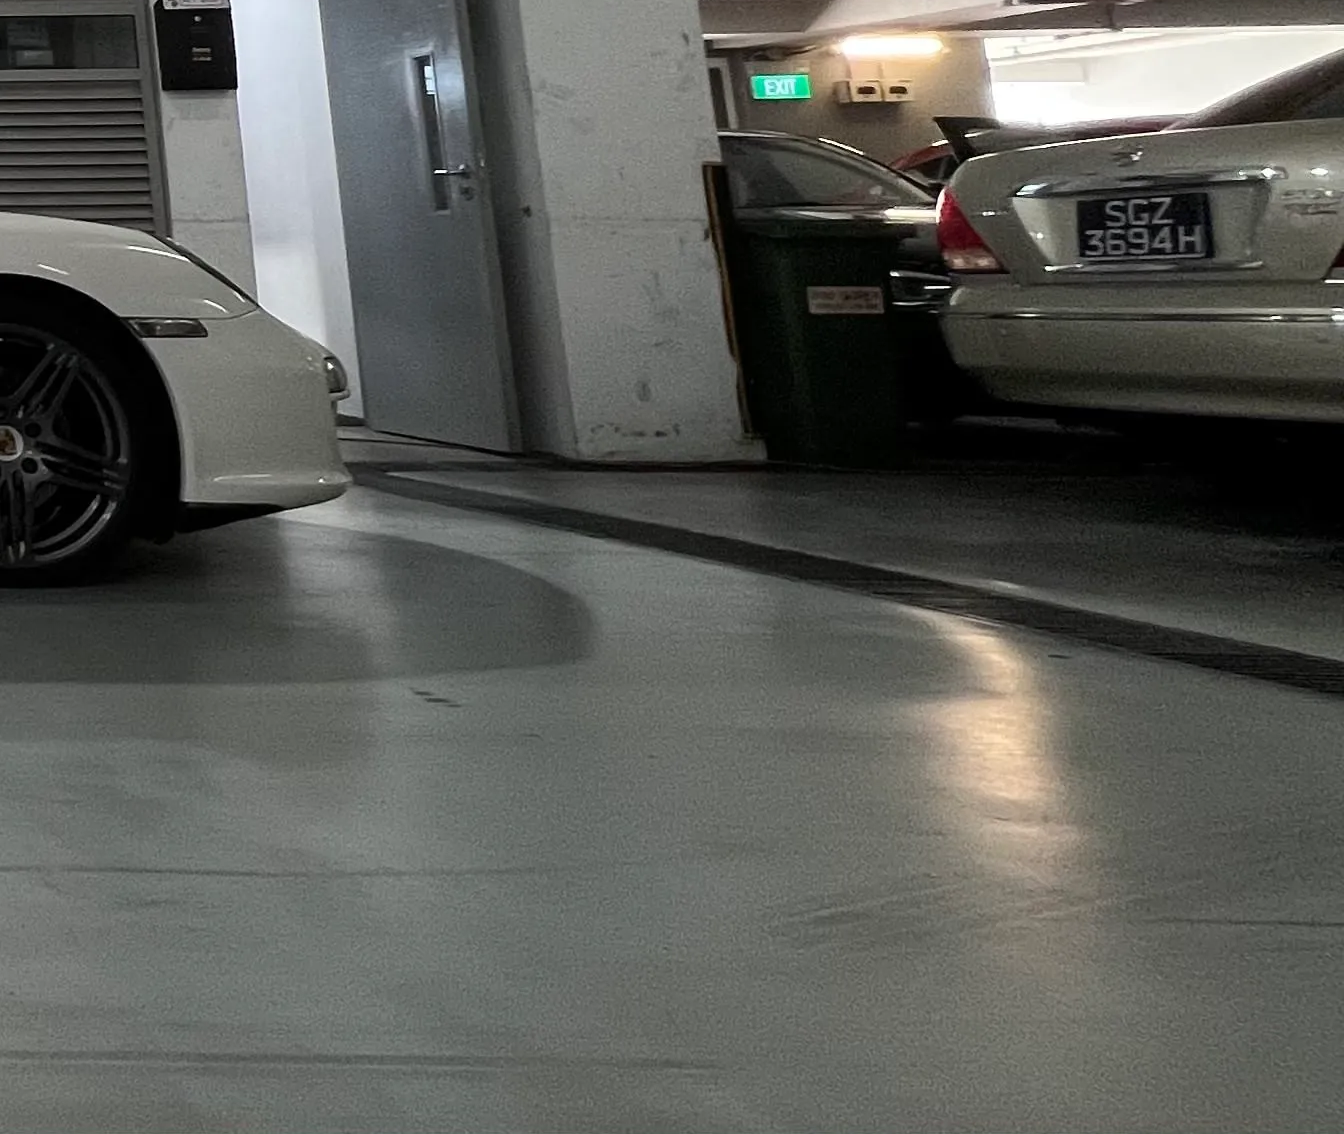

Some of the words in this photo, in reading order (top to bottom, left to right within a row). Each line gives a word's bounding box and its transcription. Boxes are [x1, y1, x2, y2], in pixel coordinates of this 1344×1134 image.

[764, 78, 796, 96] EXIT
[1104, 197, 1173, 227] SGZ
[1084, 224, 1203, 257] 3694H
